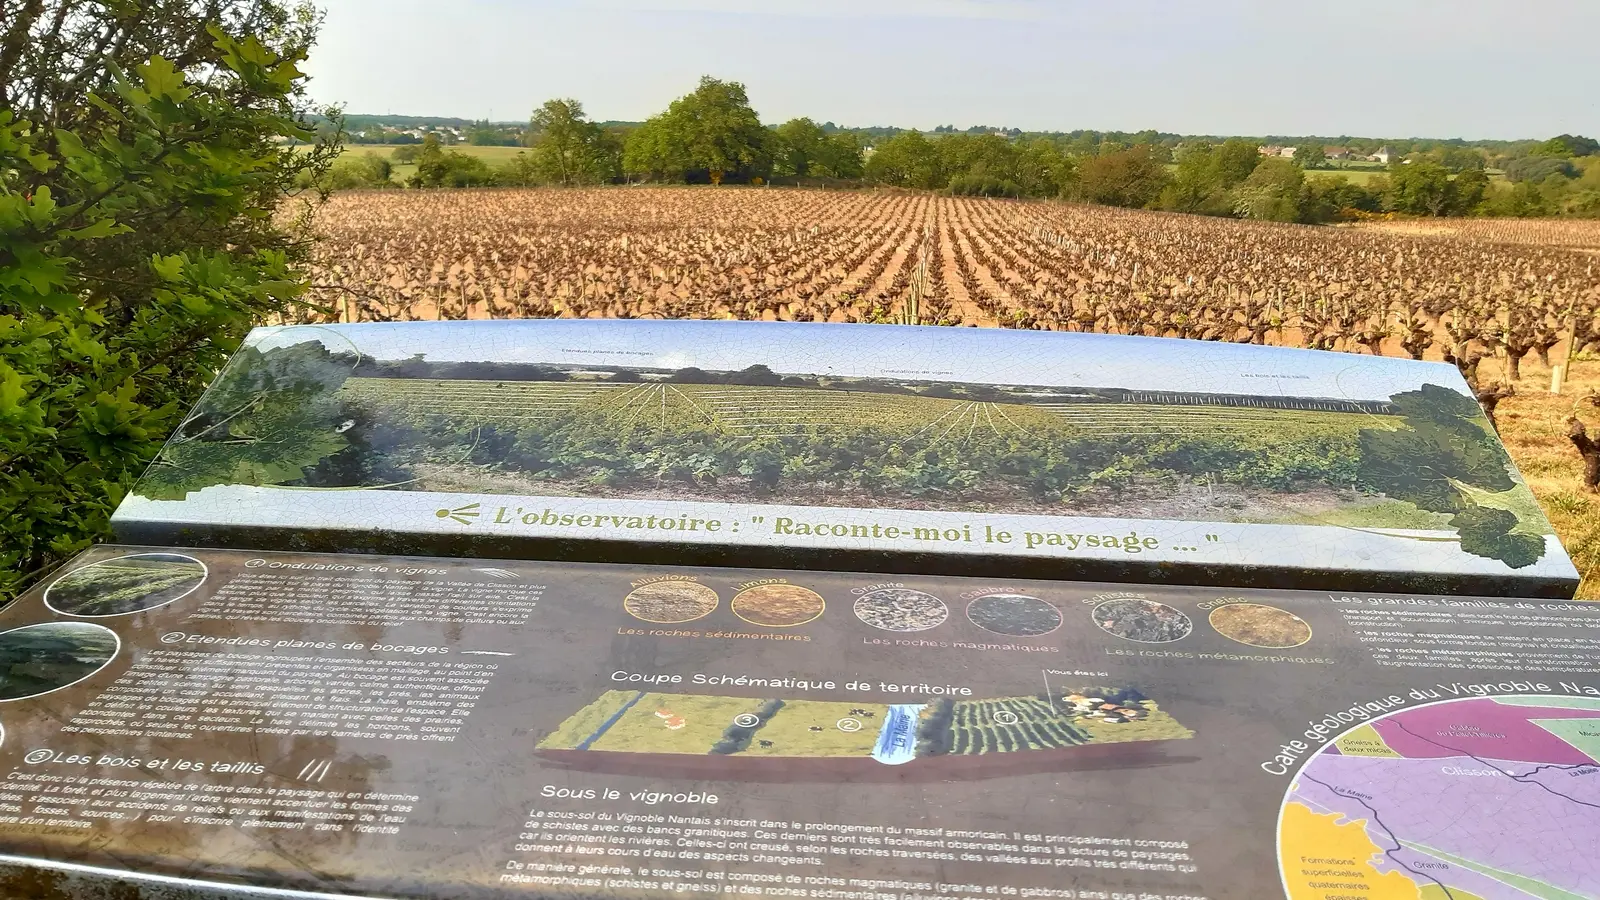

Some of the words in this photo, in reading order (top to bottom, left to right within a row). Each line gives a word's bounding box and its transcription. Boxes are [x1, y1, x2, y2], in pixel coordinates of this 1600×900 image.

[493, 506, 721, 532] L'observatoire
[774, 517, 970, 542] Raconte-moi
[986, 526, 1012, 543] le
[1025, 531, 1159, 552] paysage
[269, 562, 364, 572] Ondulations
[369, 565, 388, 573] de
[396, 567, 447, 576] vignes
[630, 574, 697, 588] Alluvions
[731, 577, 787, 592] Limons
[850, 581, 904, 595] Granite
[959, 586, 1015, 600] Gabbro
[1329, 594, 1362, 604] Les
[1368, 597, 1439, 607] grandes
[1441, 598, 1510, 609] familles
[1514, 602, 1535, 610] de
[1540, 603, 1600, 612] roches
[617, 627, 644, 635] Les
[649, 629, 700, 638] roches
[705, 631, 811, 642] sédimentaires
[186, 635, 270, 647] Etendues
[275, 639, 337, 650] planes
[342, 642, 364, 650] de
[370, 643, 448, 654] bocages
[863, 637, 890, 645] Les
[896, 638, 948, 648] roches
[953, 641, 1059, 653] magmatiques
[1140, 650, 1194, 659] roches
[1200, 652, 1334, 665] métamorphiques
[611, 670, 682, 685] Coupe
[692, 673, 836, 691] Schématique
[845, 679, 871, 692] de
[880, 681, 972, 697] territoire
[1261, 740, 1308, 776] Carte
[1304, 694, 1405, 743] géologique
[1408, 688, 1441, 700] du
[1437, 681, 1552, 696] Vignoble
[892, 736, 905, 748] La
[53, 752, 91, 764] Les
[96, 755, 141, 768] bois
[147, 758, 166, 769] et
[172, 758, 204, 772] les
[210, 760, 265, 774] taillis
[1442, 767, 1501, 777] Clisson
[7, 772, 35, 781] C'est
[36, 773, 61, 782] donc
[63, 775, 76, 783] ici
[77, 776, 88, 784] la
[90, 777, 139, 788] présence
[140, 779, 182, 791] répétée
[184, 782, 199, 791] de
[201, 784, 234, 793] l'arbre
[236, 785, 263, 794] dans
[267, 787, 274, 795] le
[276, 788, 324, 799] paysage
[328, 790, 343, 800] qui
[364, 792, 419, 802] détermine
[540, 786, 596, 799] Sous
[602, 788, 620, 800] le
[630, 789, 719, 804] vignoble
[529, 809, 544, 818] Le
[547, 810, 594, 820] sous-sol
[598, 812, 612, 820] du
[616, 812, 664, 824] Vignoble
[668, 815, 710, 825] Nantais
[714, 817, 756, 827] s'inscrit
[760, 819, 788, 829] dans
[792, 821, 802, 830] le
[805, 822, 884, 835] prolongement
[887, 825, 901, 834] du
[905, 827, 942, 836] massif
[946, 829, 1010, 840] armoricain.
[1014, 832, 1020, 840] Il
[1024, 833, 1041, 842] est
[1045, 833, 1132, 847] principalement
[1135, 839, 1188, 850] composé
[525, 820, 539, 828] de
[543, 821, 588, 831] schistes
[592, 824, 619, 832] avec
[622, 825, 643, 834] des
[647, 826, 681, 835] bancs
[684, 828, 750, 839] granitiques.
[754, 830, 777, 840] Ces
[780, 832, 827, 842] derniers
[831, 834, 856, 844] sont
[859, 835, 881, 845] très
[885, 836, 944, 848] facilement
[948, 840, 1019, 851] observables
[1022, 844, 1051, 854] dans
[1054, 846, 1066, 855] la
[1068, 847, 1109, 857] lecture
[1112, 849, 1128, 858] de
[1131, 850, 1194, 861] paysages.
[1301, 856, 1356, 866] Formations
[1413, 861, 1449, 870] Granite
[1301, 869, 1364, 878] superficielles
[1308, 881, 1370, 890] quaternaires
